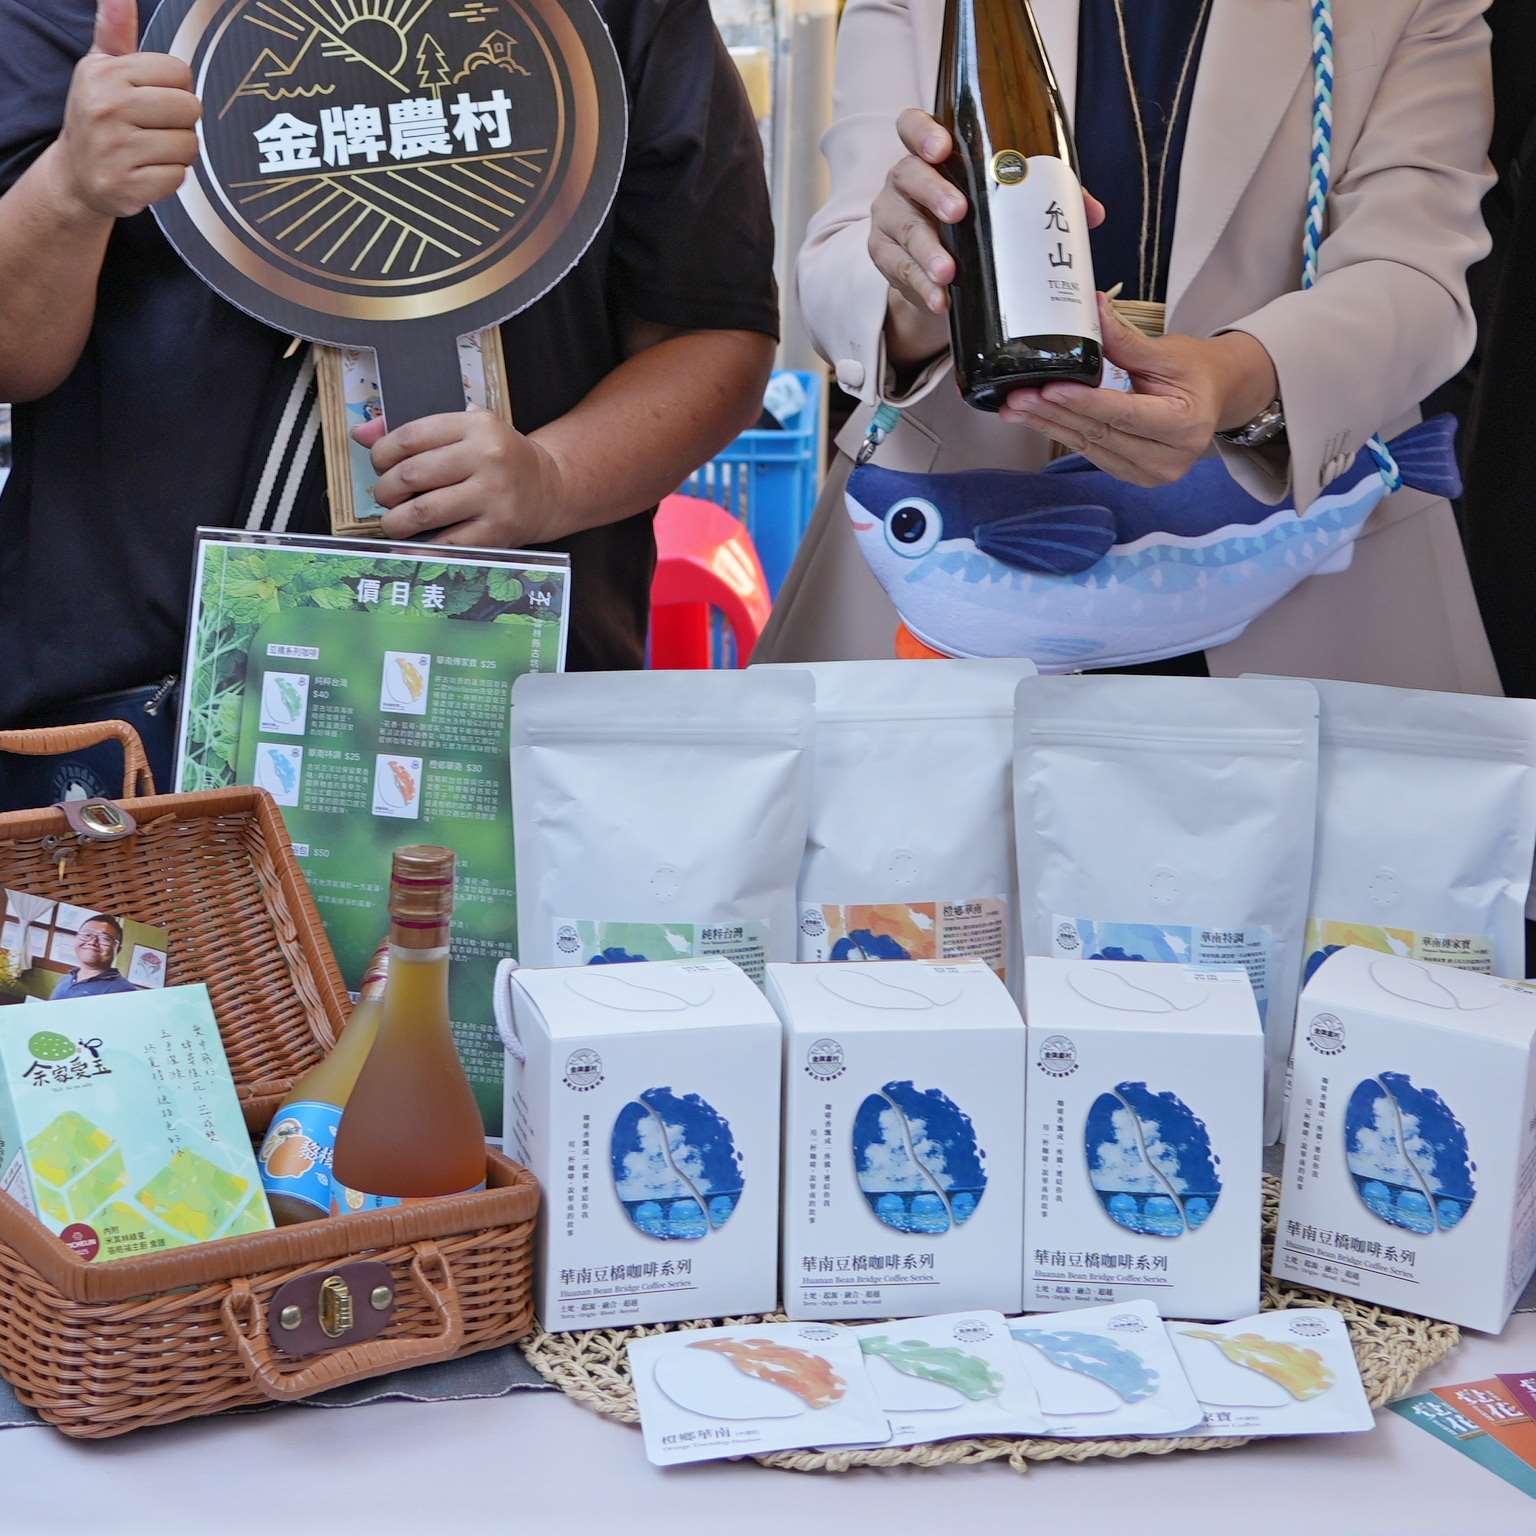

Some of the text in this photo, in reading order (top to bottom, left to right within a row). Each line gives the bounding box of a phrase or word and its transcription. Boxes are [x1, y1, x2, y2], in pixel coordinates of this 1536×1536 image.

[253, 89, 514, 174] 金牌農村
[1044, 200, 1073, 270] 允山
[357, 578, 447, 610] 價目表
[480, 659, 497, 670] $25
[312, 690, 330, 699] $40
[344, 752, 361, 761] $25
[465, 763, 483, 773] $30
[1286, 1219, 1417, 1267] 華南豆橋咖啡系列
[800, 1253, 935, 1273] 華南豆橋咖啡系列
[1033, 1249, 1168, 1271] 華南豆橋咖啡系列
[1286, 1239, 1415, 1279] Huanan Bean Bridge Coffee Series
[559, 1258, 693, 1286] 華南豆橋咖啡系列
[857, 1275, 882, 1284] Bridge
[884, 1274, 909, 1282] Coffee
[910, 1273, 934, 1281] Series
[1034, 1270, 1167, 1283] Huanan Bean Bridge Coffee Series
[560, 1280, 692, 1298] Huanan Bean Bridge Coffee Series
